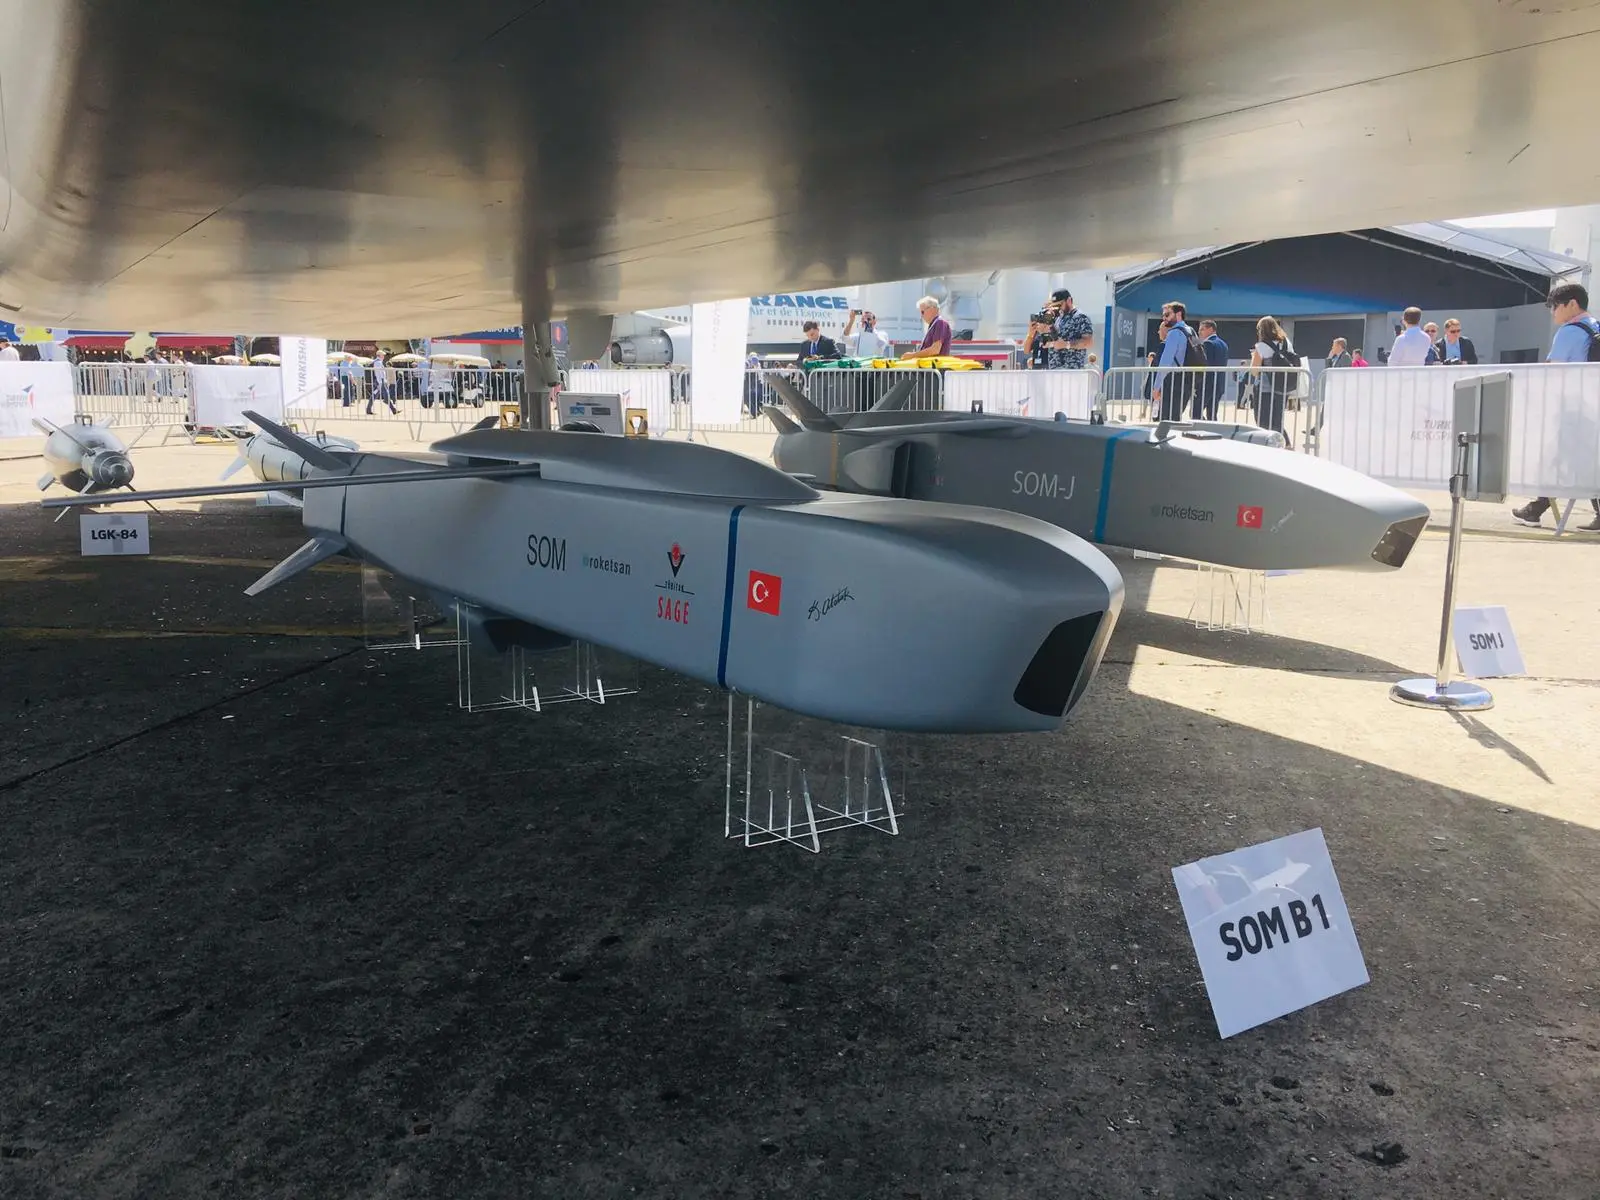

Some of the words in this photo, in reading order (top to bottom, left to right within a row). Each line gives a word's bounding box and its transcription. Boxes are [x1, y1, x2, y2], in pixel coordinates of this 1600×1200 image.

[750, 295, 848, 309] RANCE
[1012, 470, 1076, 500] SOM-J
[1161, 504, 1214, 522] roketsan
[91, 529, 138, 540] LGK-84
[527, 534, 566, 571] SOM
[589, 556, 631, 575] roketsan
[657, 595, 689, 625] SAGE
[1469, 632, 1498, 650] SOM
[1497, 632, 1504, 649] J
[1219, 905, 1290, 962] SOM
